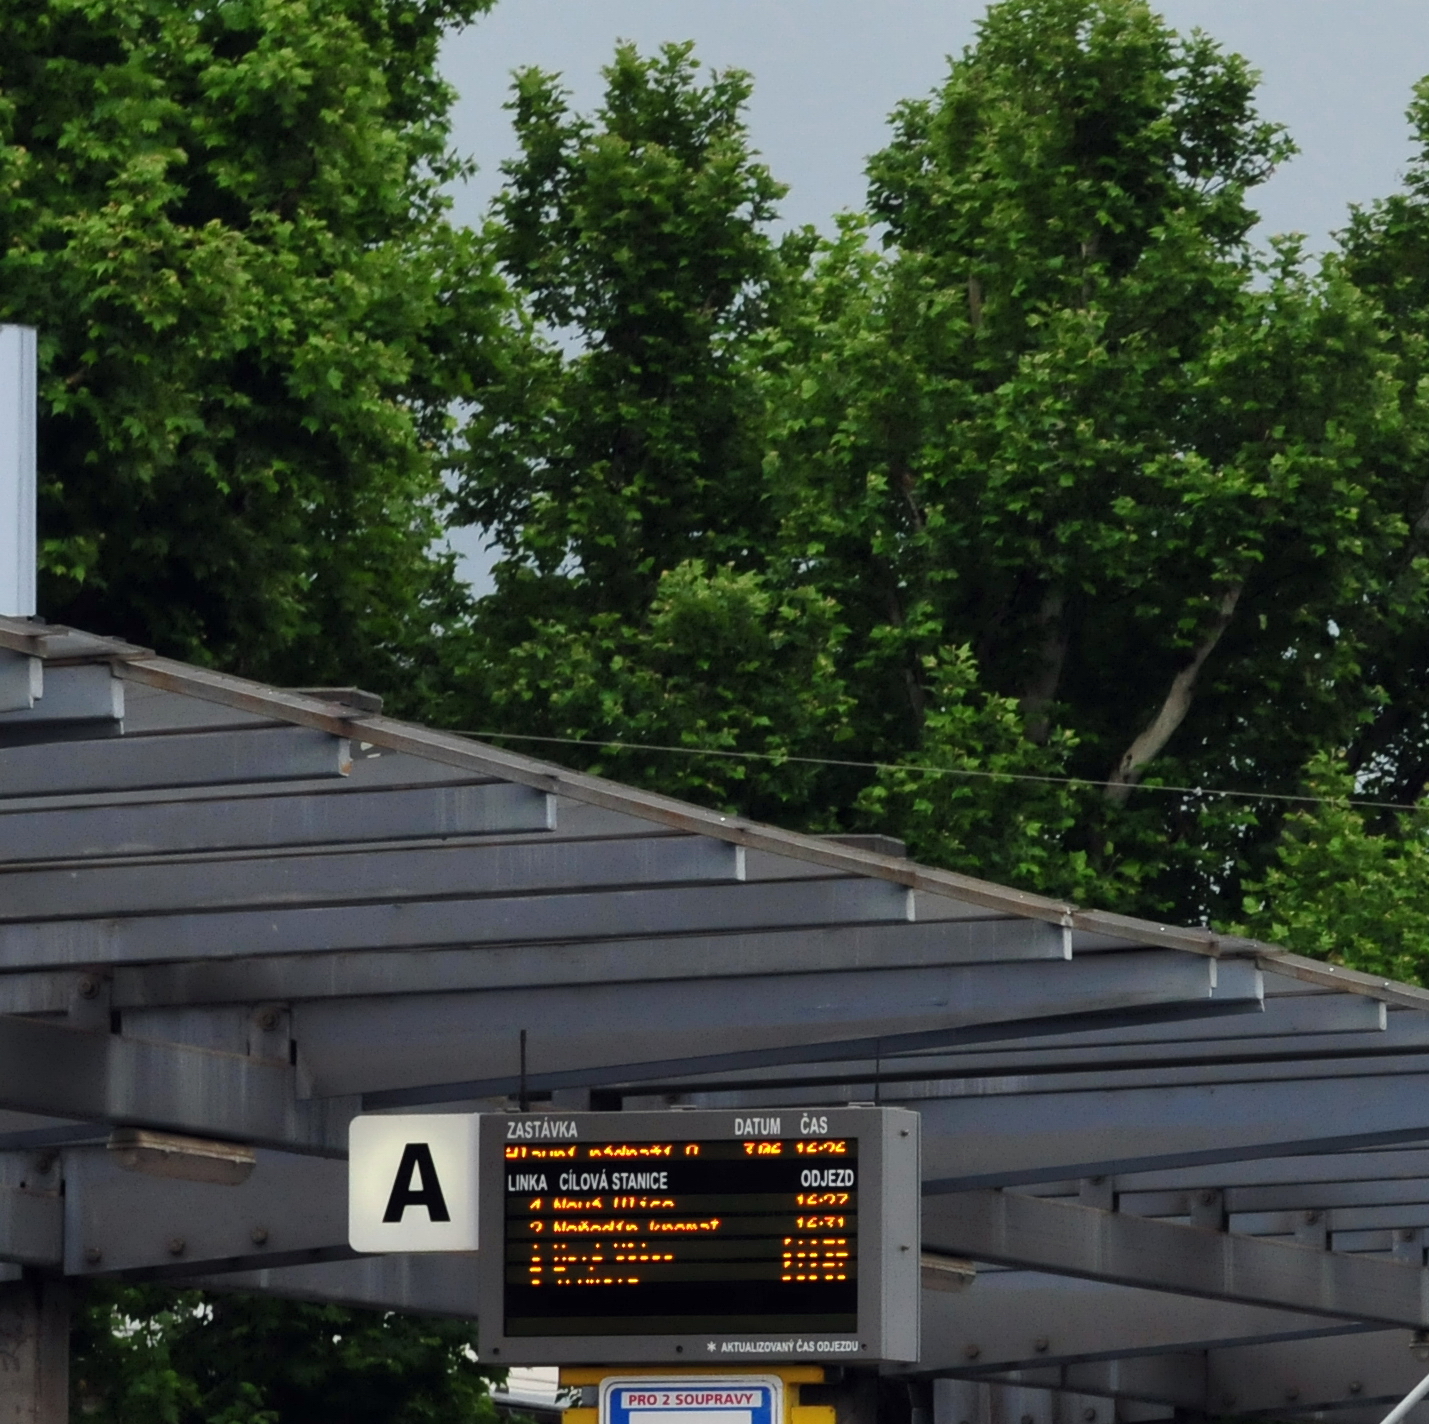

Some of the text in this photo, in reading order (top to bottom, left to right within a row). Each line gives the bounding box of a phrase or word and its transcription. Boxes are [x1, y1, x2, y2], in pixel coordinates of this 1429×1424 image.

[507, 1117, 578, 1139] ZASTÁVKA
[734, 1117, 781, 1136] DATUM
[800, 1112, 828, 1134] ČAS
[382, 1143, 450, 1223] A
[508, 1174, 548, 1191] LINKA
[559, 1168, 668, 1191] CÍLOVÁ STANICE
[801, 1168, 854, 1188] ODJEZD
[721, 1338, 859, 1353] AKTUALIZOVANÝ ČAS ODJEZDU
[628, 1393, 754, 1407] PRO 2 SOUPRAVY
